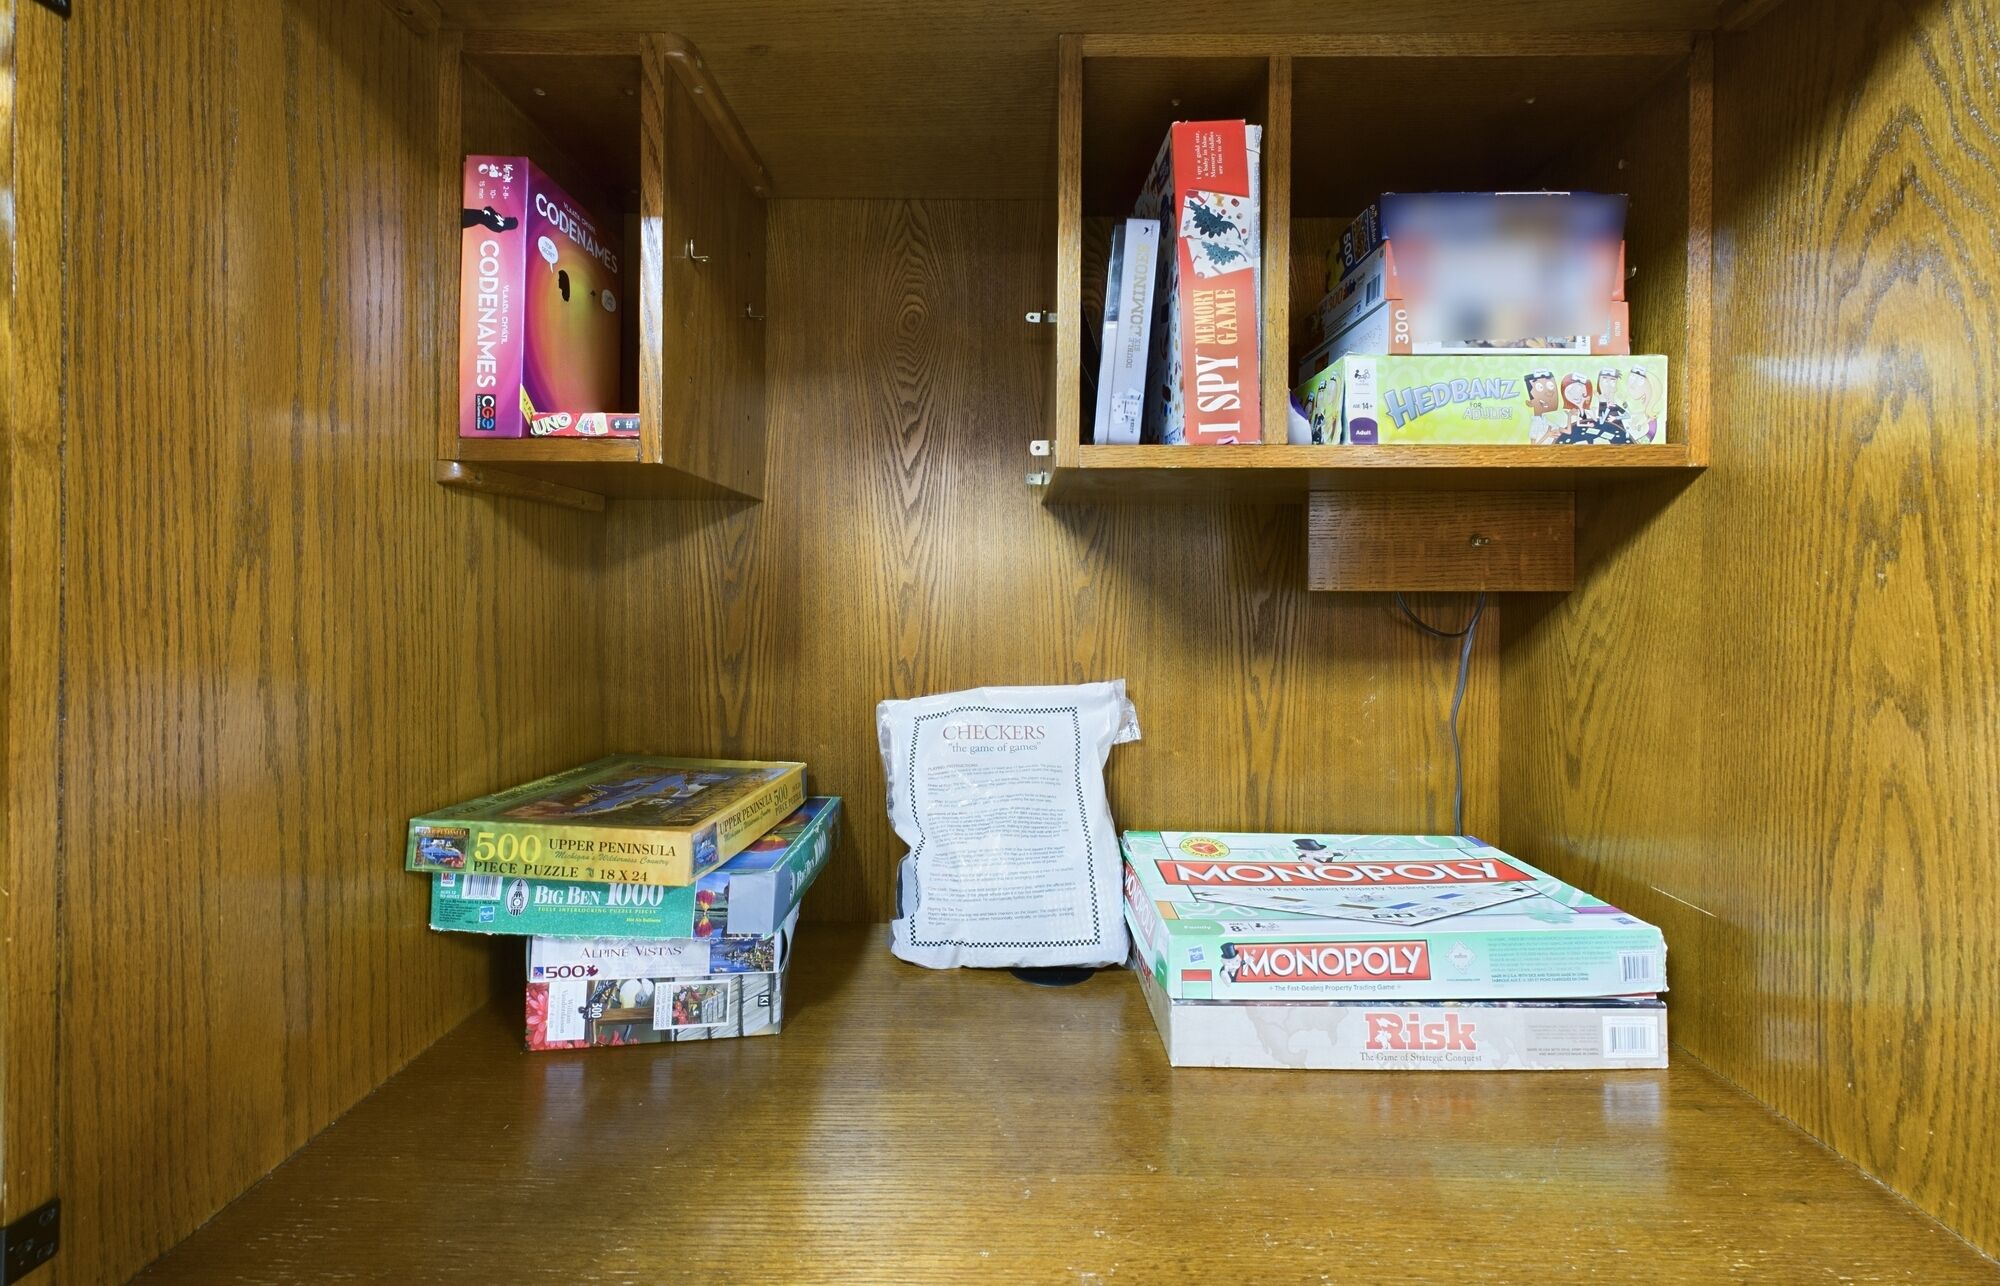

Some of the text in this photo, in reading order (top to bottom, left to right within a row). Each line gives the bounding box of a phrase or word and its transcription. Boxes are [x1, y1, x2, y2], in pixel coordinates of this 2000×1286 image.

[1202, 157, 1210, 172] baby
[535, 193, 618, 274] CODENAMES
[1343, 232, 1353, 267] 500
[476, 240, 500, 388] CODENAMES
[1193, 289, 1216, 345] MEMORY
[1216, 288, 1238, 346] GAME
[1394, 309, 1409, 345] 300
[1195, 354, 1241, 435] I SPY
[1384, 377, 1520, 429] HEDBANZ
[531, 414, 570, 435] UNO
[1463, 407, 1513, 420] ADULTS!
[942, 724, 1045, 741] CHECKERS
[969, 744, 995, 755] game
[997, 742, 1007, 752] of
[773, 783, 788, 807] 500
[719, 794, 773, 836] UPPER PENINSULA
[473, 832, 542, 864] 500
[549, 838, 677, 857] UPPER PENINSULA
[473, 861, 579, 878] PIECE PUZZLE
[599, 869, 649, 882] 18 X 24
[1175, 863, 1498, 883] MONOPOLY
[533, 882, 665, 907] BIG BEN 1000
[580, 945, 682, 959] ALPINE VISTAS
[1241, 946, 1422, 977] MONOPOLY
[545, 965, 586, 979] 500
[1286, 984, 1324, 993] Fast-Dealing
[1324, 984, 1352, 993] Property
[1353, 984, 1377, 993] Trading
[566, 998, 574, 1025] William
[591, 1002, 603, 1018] 300
[1364, 1012, 1477, 1051] Risk
[1360, 1051, 1482, 1065] The Game of Strategic Conquest
